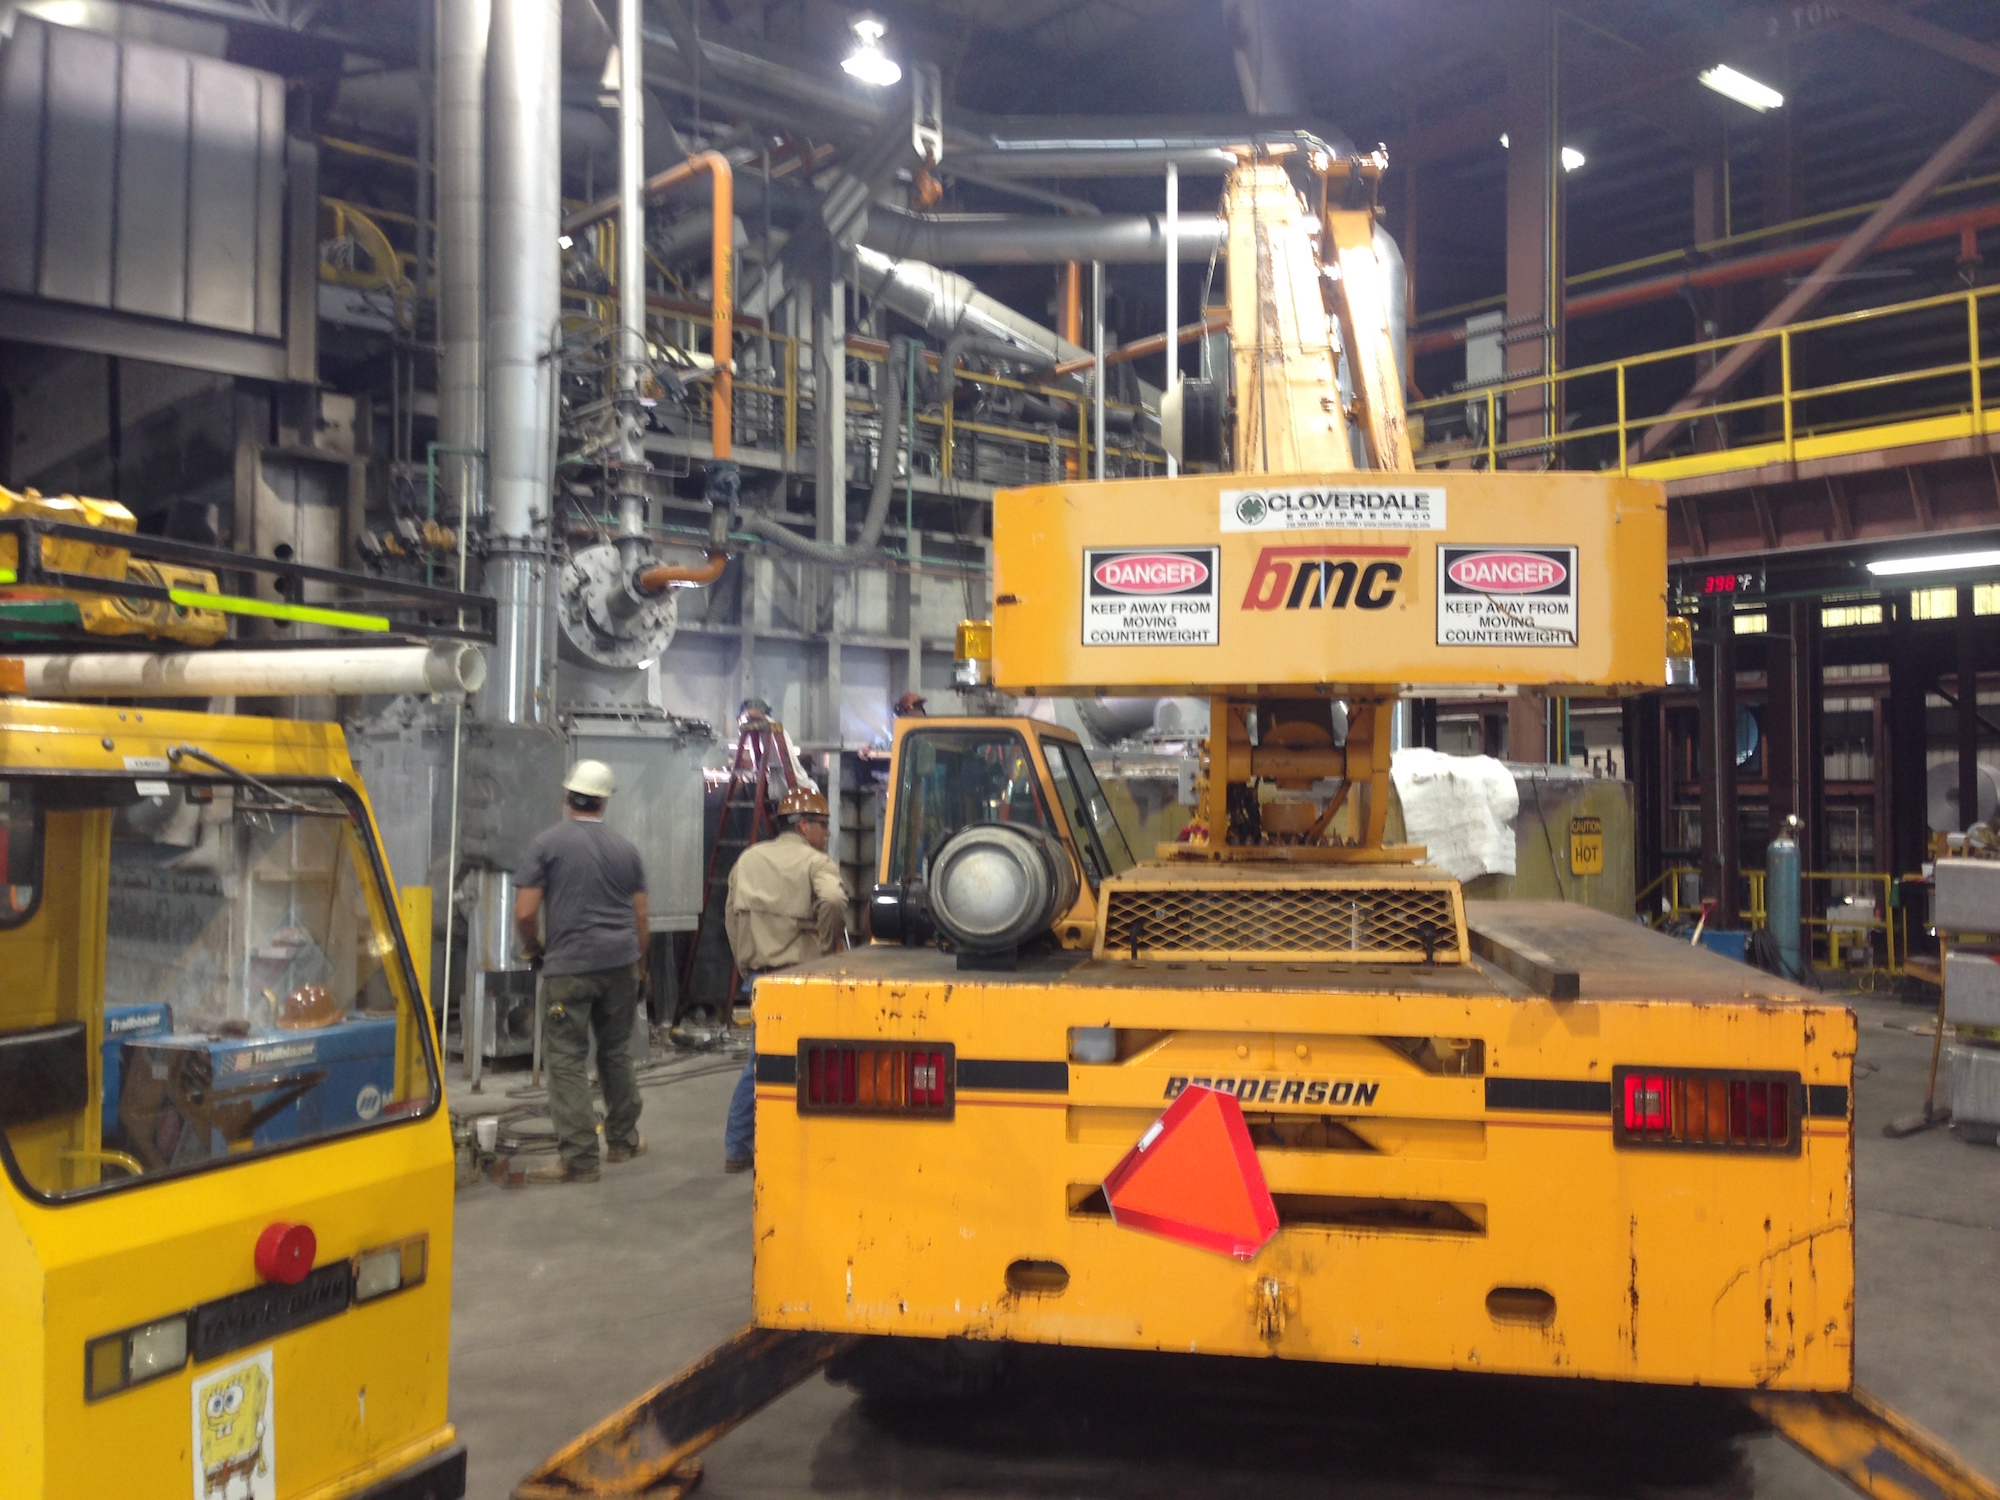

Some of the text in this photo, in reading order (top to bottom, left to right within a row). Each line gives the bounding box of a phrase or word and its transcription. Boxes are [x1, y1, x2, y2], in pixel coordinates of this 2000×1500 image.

[1268, 492, 1430, 511] CLOVERDALE
[1286, 511, 1404, 521] EQUIPMENT
[1105, 563, 1196, 584] DANGER
[1241, 545, 1411, 611] bmc
[1460, 562, 1554, 583] DANGER
[1091, 601, 1210, 615] KEEP AWAY FROM
[1446, 602, 1569, 614] KEEP AWAY FROM
[1123, 616, 1177, 628] MOVING
[1480, 616, 1535, 628] MOVING
[1091, 630, 1210, 642] COUNTERWEIGHT
[1446, 630, 1569, 642] COUNTERWEIGHT
[1571, 820, 1601, 833] CAUTION
[1575, 847, 1598, 863] HOT
[111, 1012, 161, 1034] Trailblazer
[255, 1042, 315, 1064] Trailblazer
